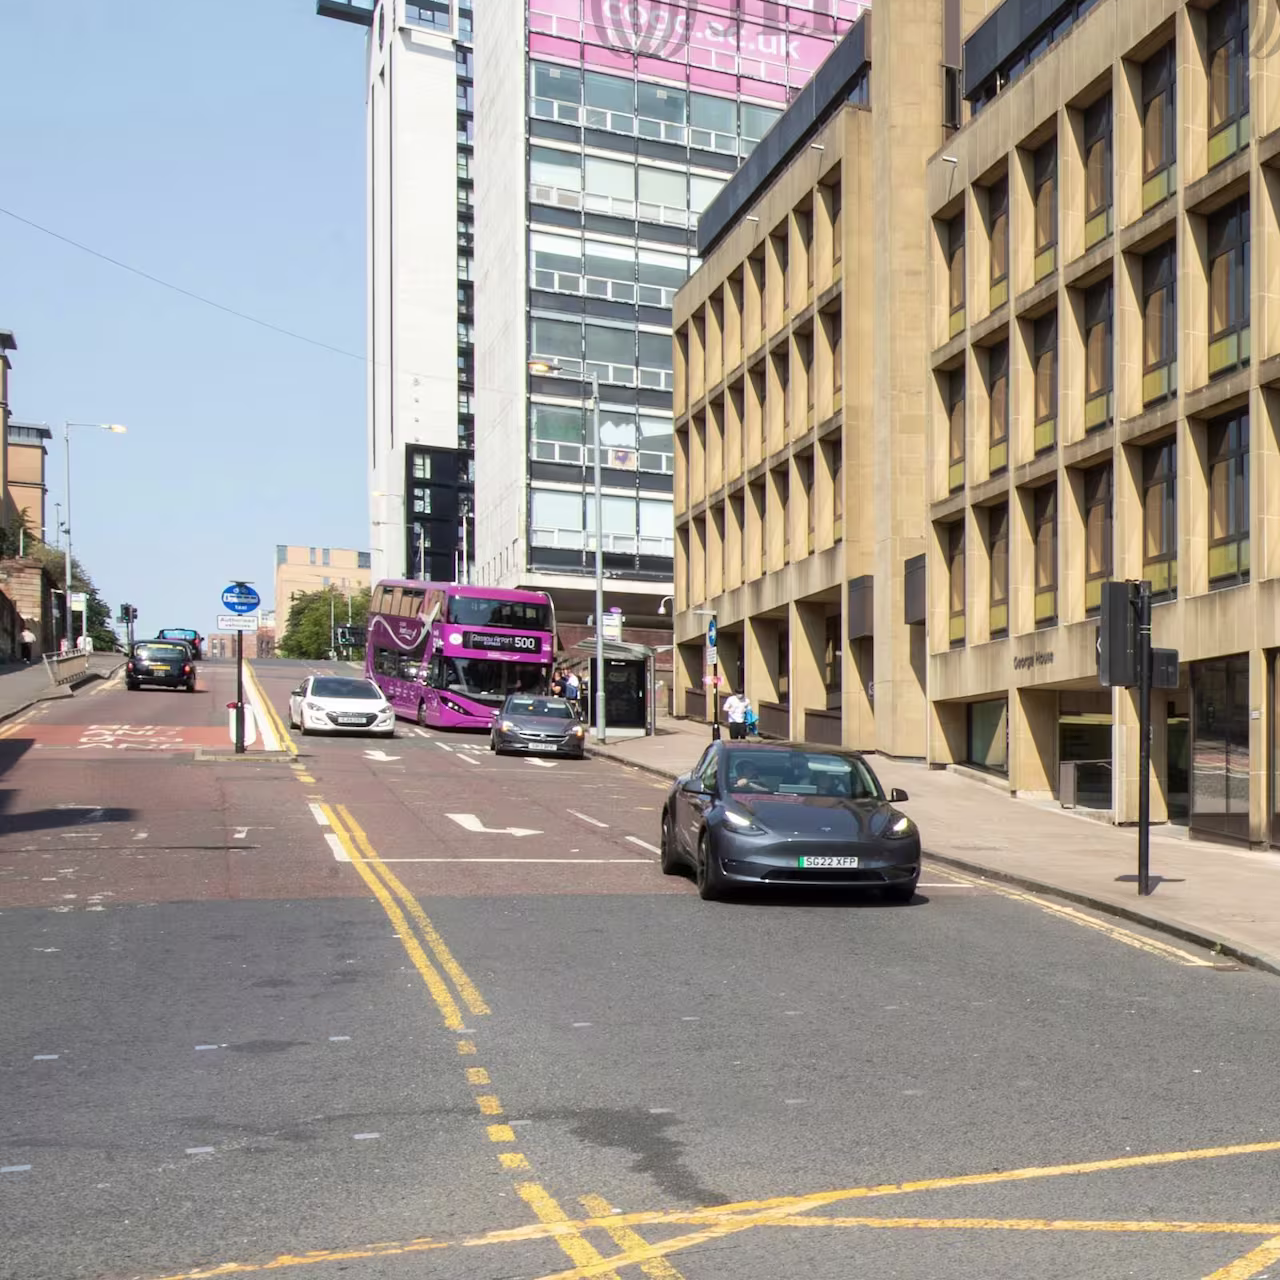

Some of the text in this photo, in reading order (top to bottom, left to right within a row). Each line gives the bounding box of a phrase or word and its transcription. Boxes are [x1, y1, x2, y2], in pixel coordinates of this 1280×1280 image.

[515, 637, 536, 650] 500
[1013, 651, 1054, 670] George House
[806, 858, 857, 867] SG22 XFP
